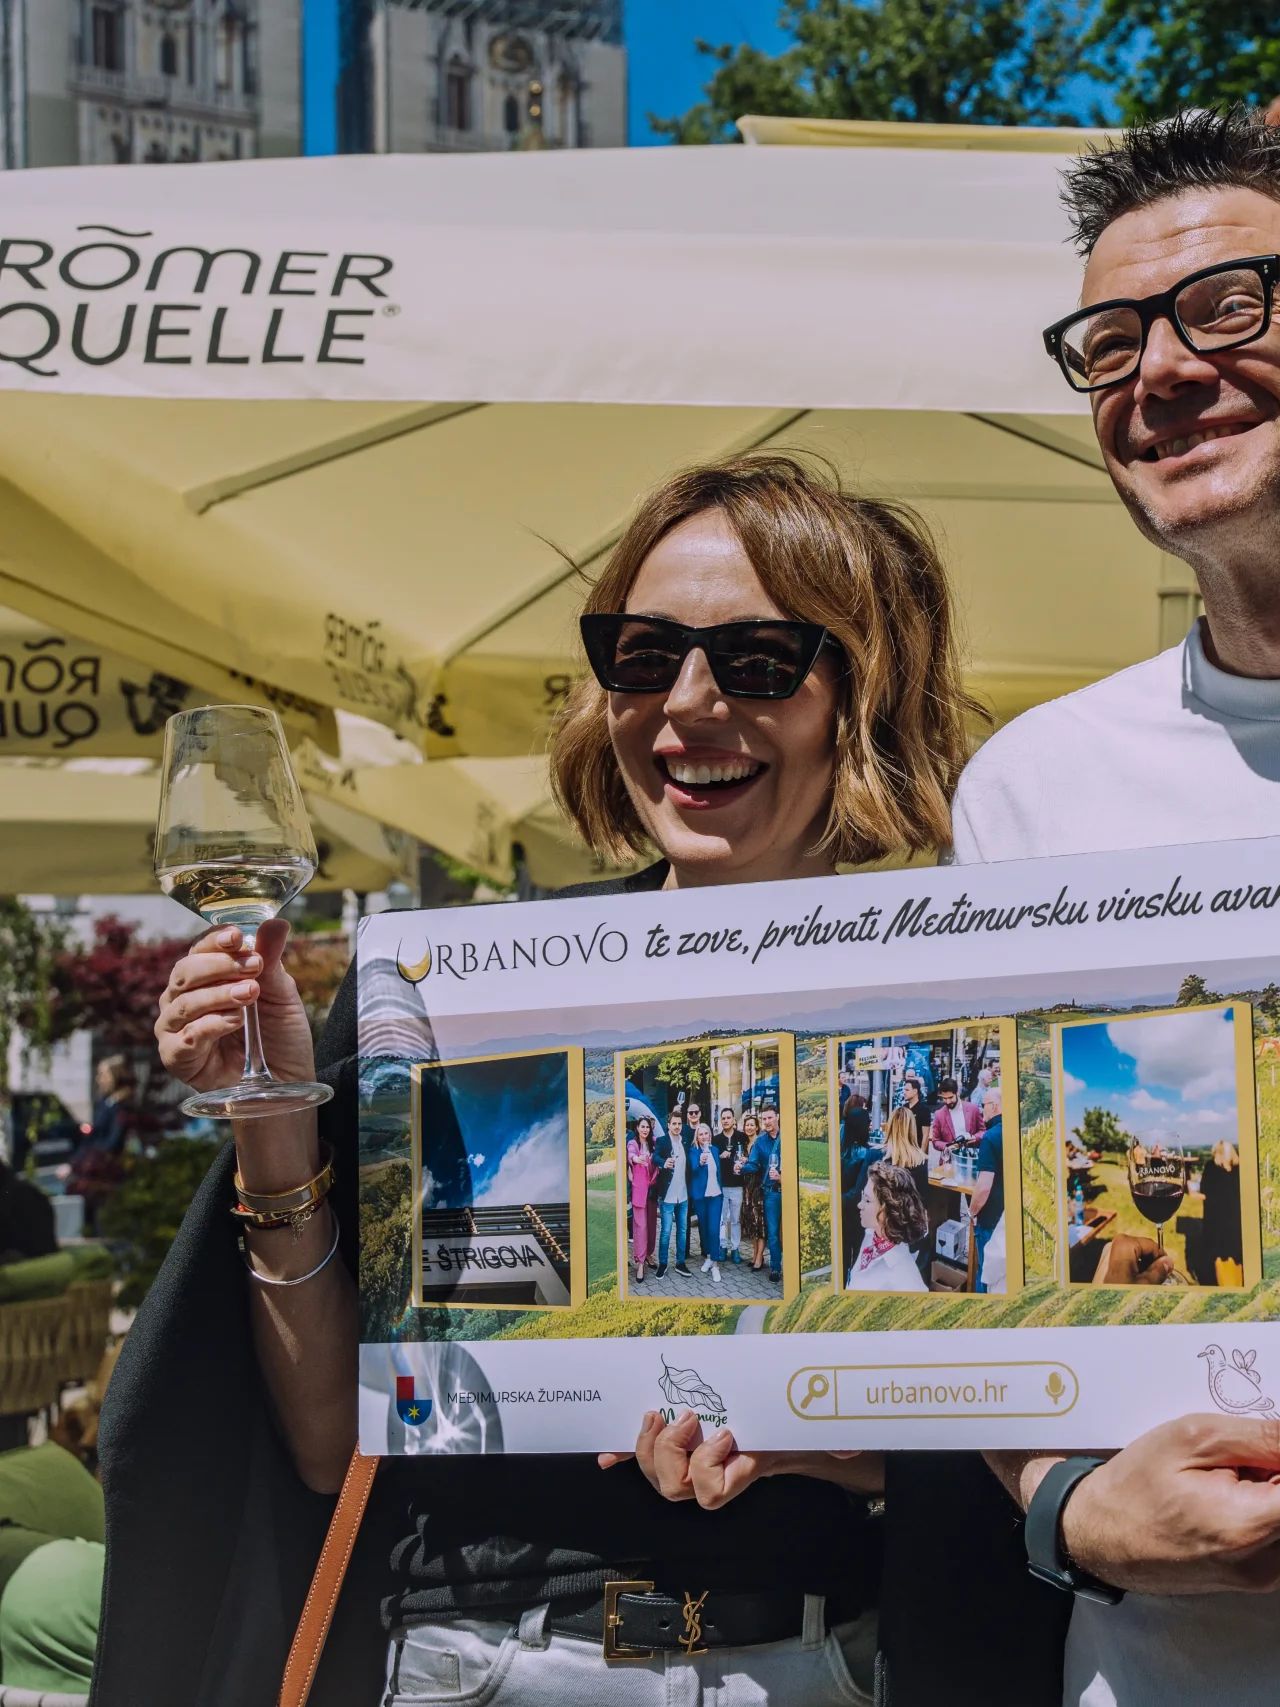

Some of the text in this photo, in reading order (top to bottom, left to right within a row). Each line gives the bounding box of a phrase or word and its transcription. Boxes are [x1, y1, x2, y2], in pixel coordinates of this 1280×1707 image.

[645, 923, 671, 958] te
[677, 927, 749, 956] zove,
[751, 904, 881, 965] prihvati
[881, 885, 1089, 945] Međimursku
[1096, 875, 1204, 923] vinsku
[1137, 1164, 1177, 1175] RBANOVO
[437, 1243, 546, 1272] ŠTRIGOVA
[538, 1387, 602, 1403] ŽUPANIJA
[866, 1379, 1009, 1405] urbanovo.hr
